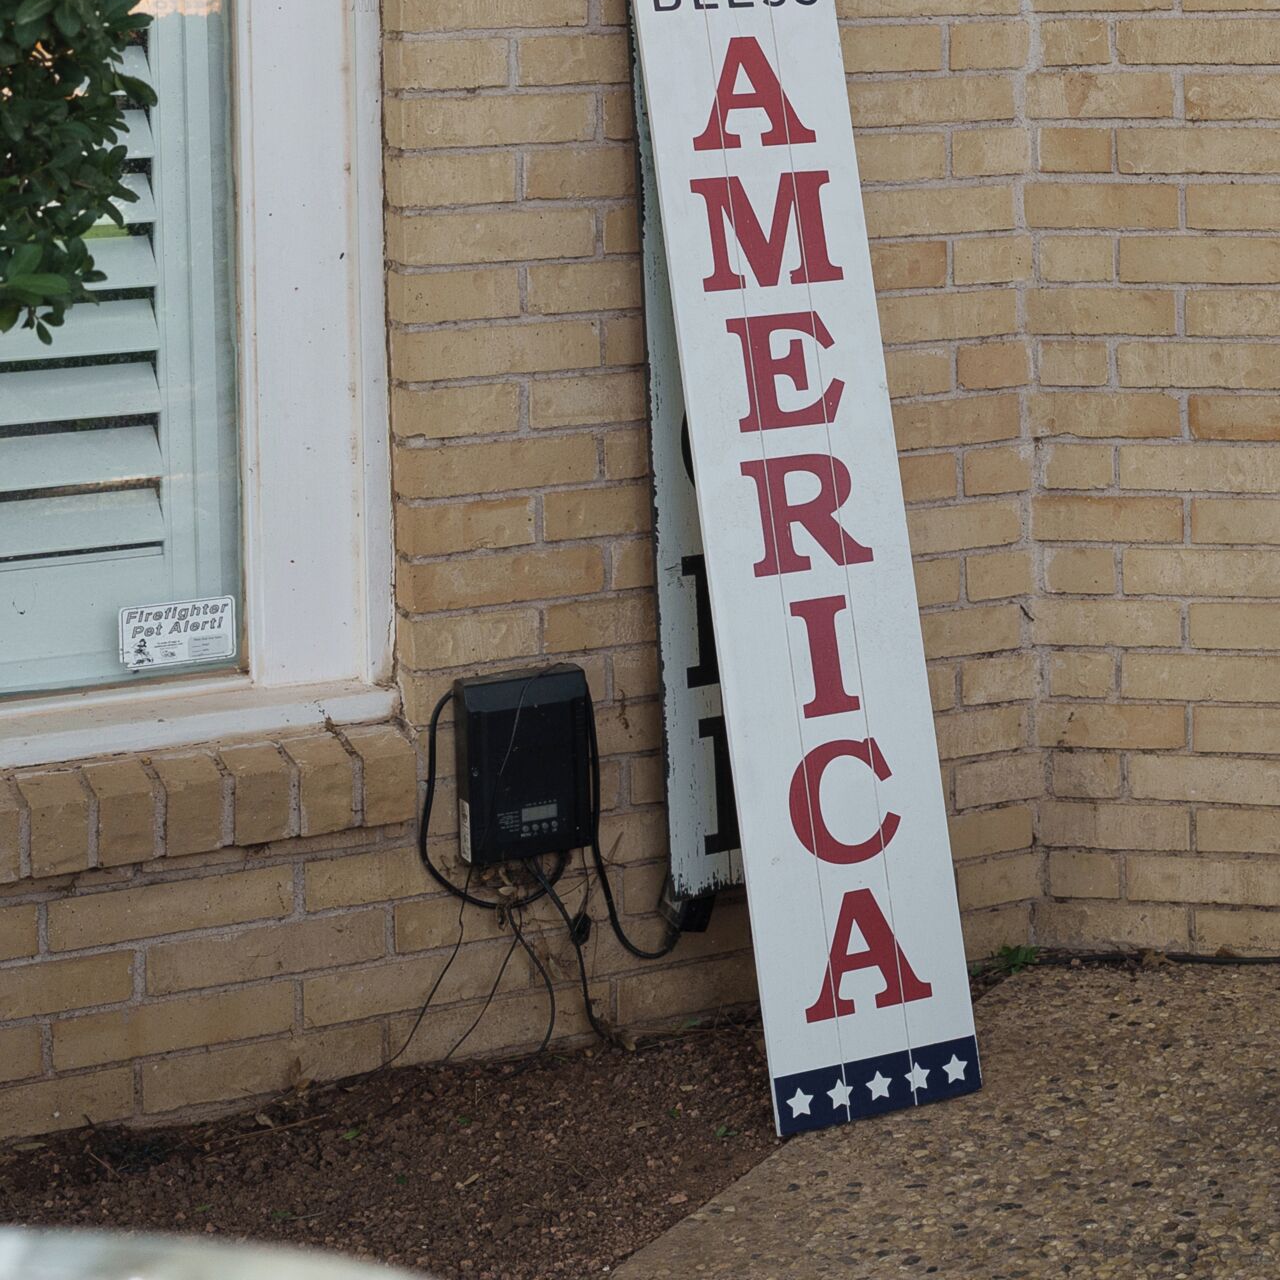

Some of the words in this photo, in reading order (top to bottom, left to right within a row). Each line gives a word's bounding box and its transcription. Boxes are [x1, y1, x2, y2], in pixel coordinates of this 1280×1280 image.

[691, 36, 932, 1023] AMERICA
[125, 603, 229, 624] Firefighter
[131, 622, 163, 639] Pet
[168, 616, 224, 635] Alert!
